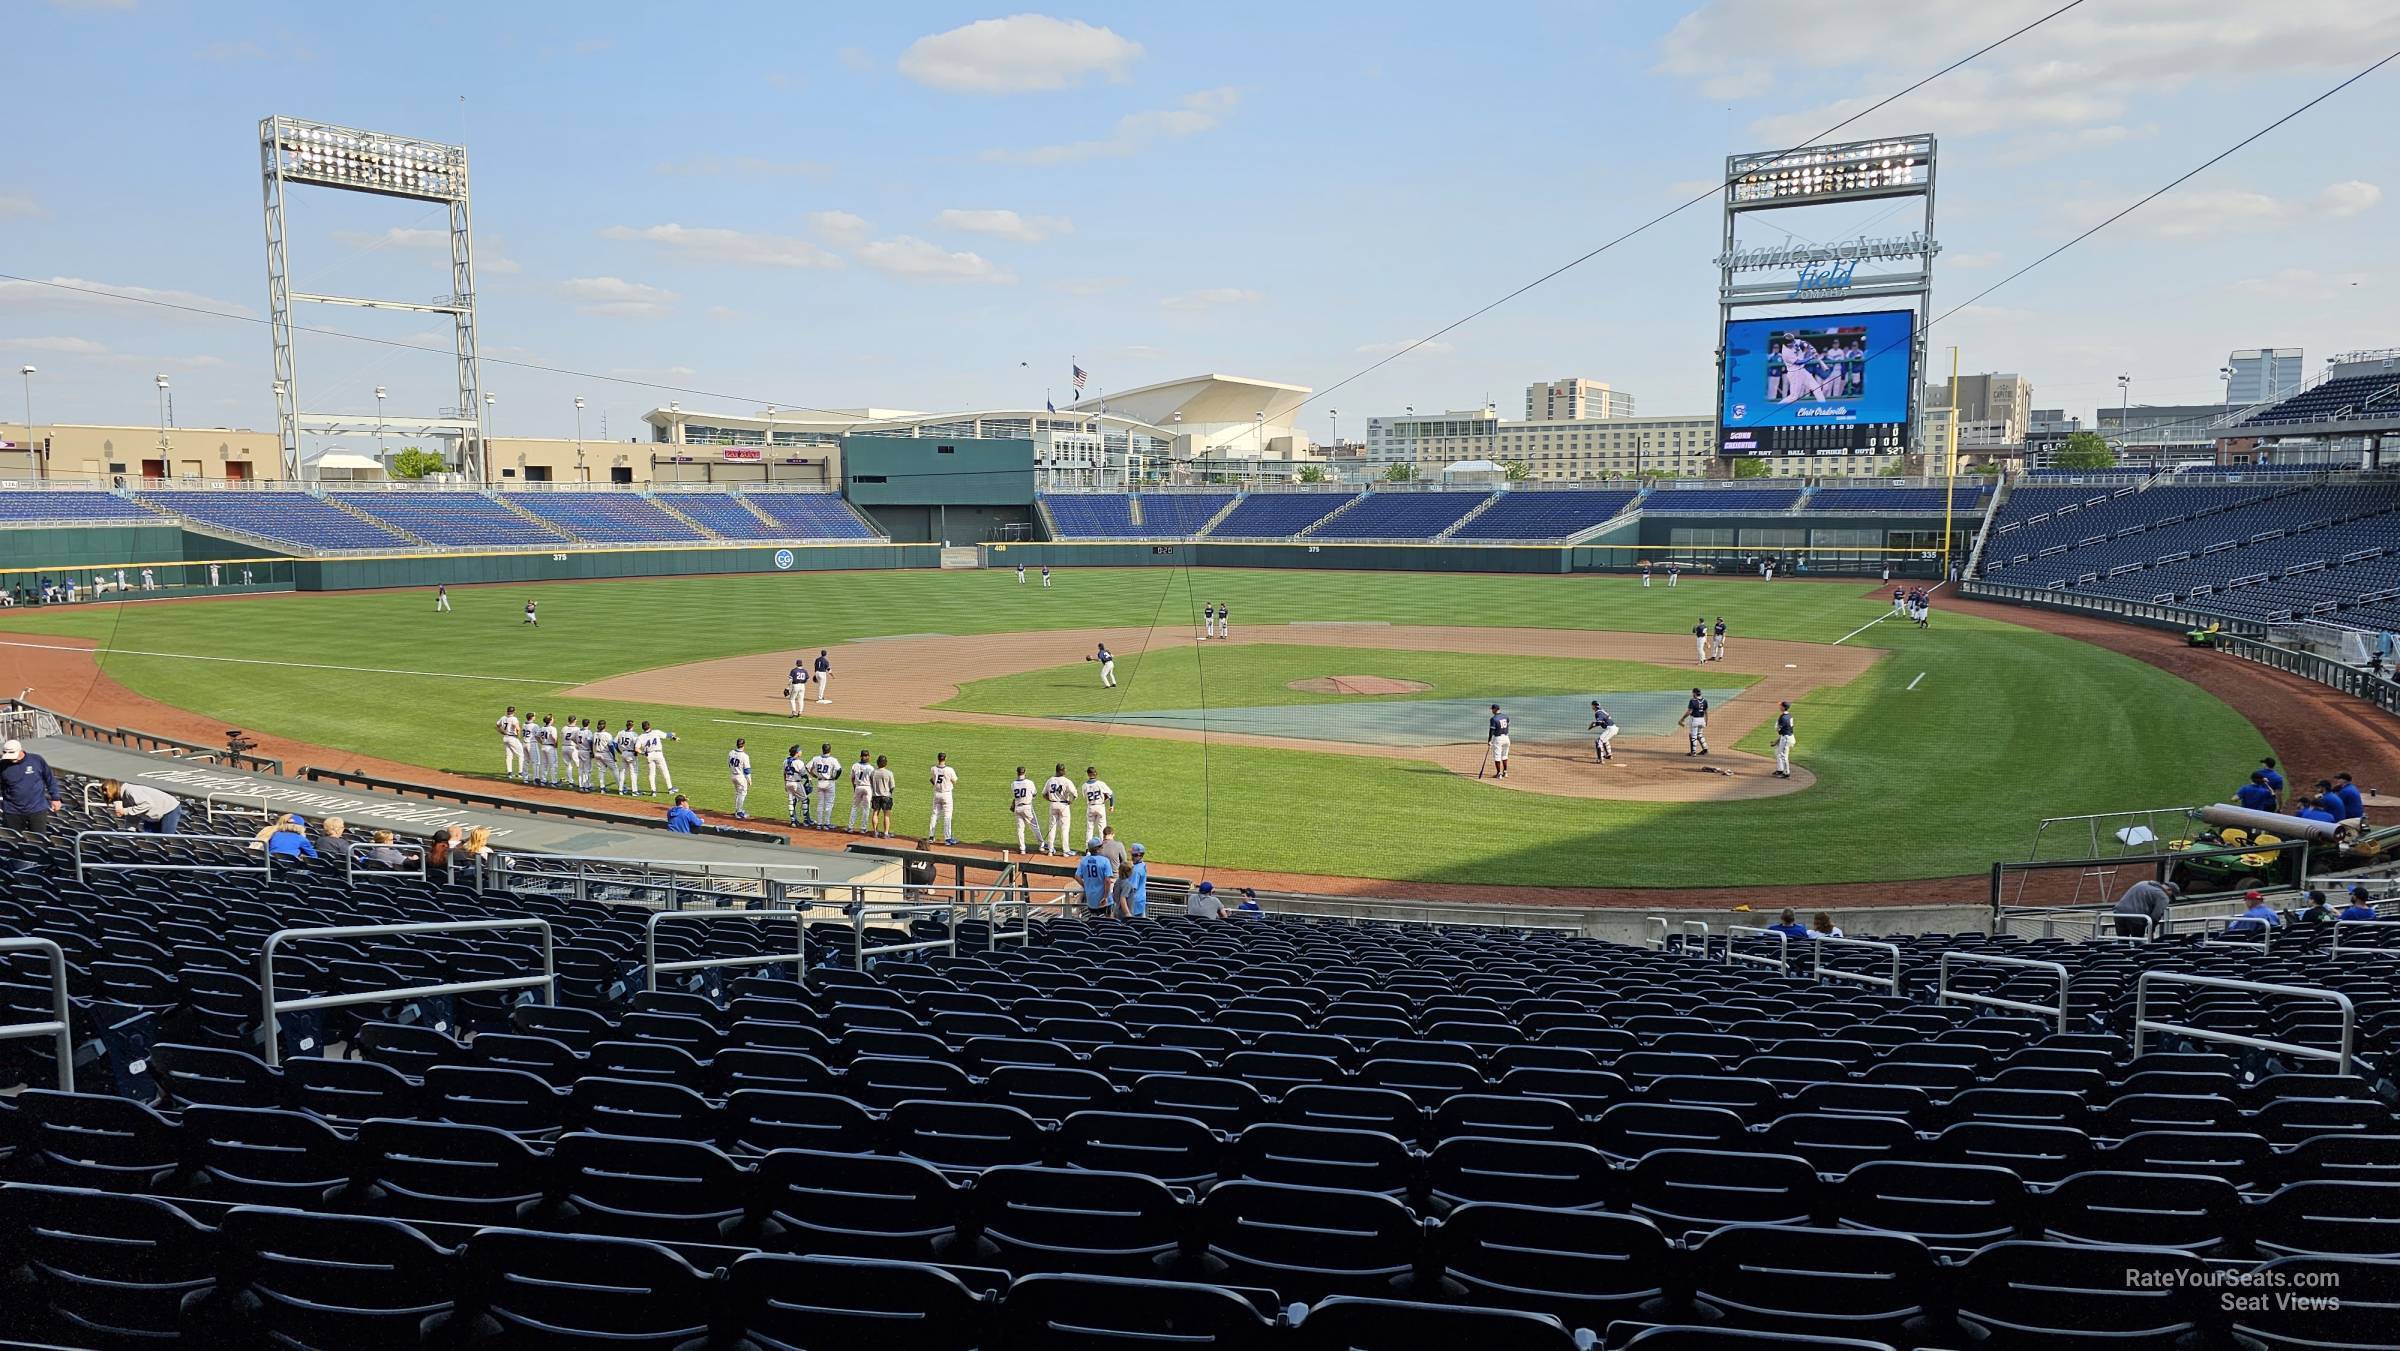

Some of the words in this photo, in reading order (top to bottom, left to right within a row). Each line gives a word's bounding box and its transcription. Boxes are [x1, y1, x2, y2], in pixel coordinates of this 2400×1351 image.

[1824, 234, 1931, 261] SCHWAB
[1789, 260, 1857, 299] field
[1801, 289, 1848, 299] OMAHA
[1893, 428, 1898, 436] 0
[1871, 438, 1876, 446] 0
[1884, 438, 1889, 446] 0
[1892, 437, 1898, 446] 0
[645, 738, 657, 747] 44
[730, 758, 740, 767] 40
[817, 764, 829, 773] 28
[937, 775, 944, 784] 5
[1014, 788, 1026, 798] 20
[1050, 784, 1062, 794] 34
[1087, 791, 1100, 801] 22
[1087, 865, 1098, 878] 18
